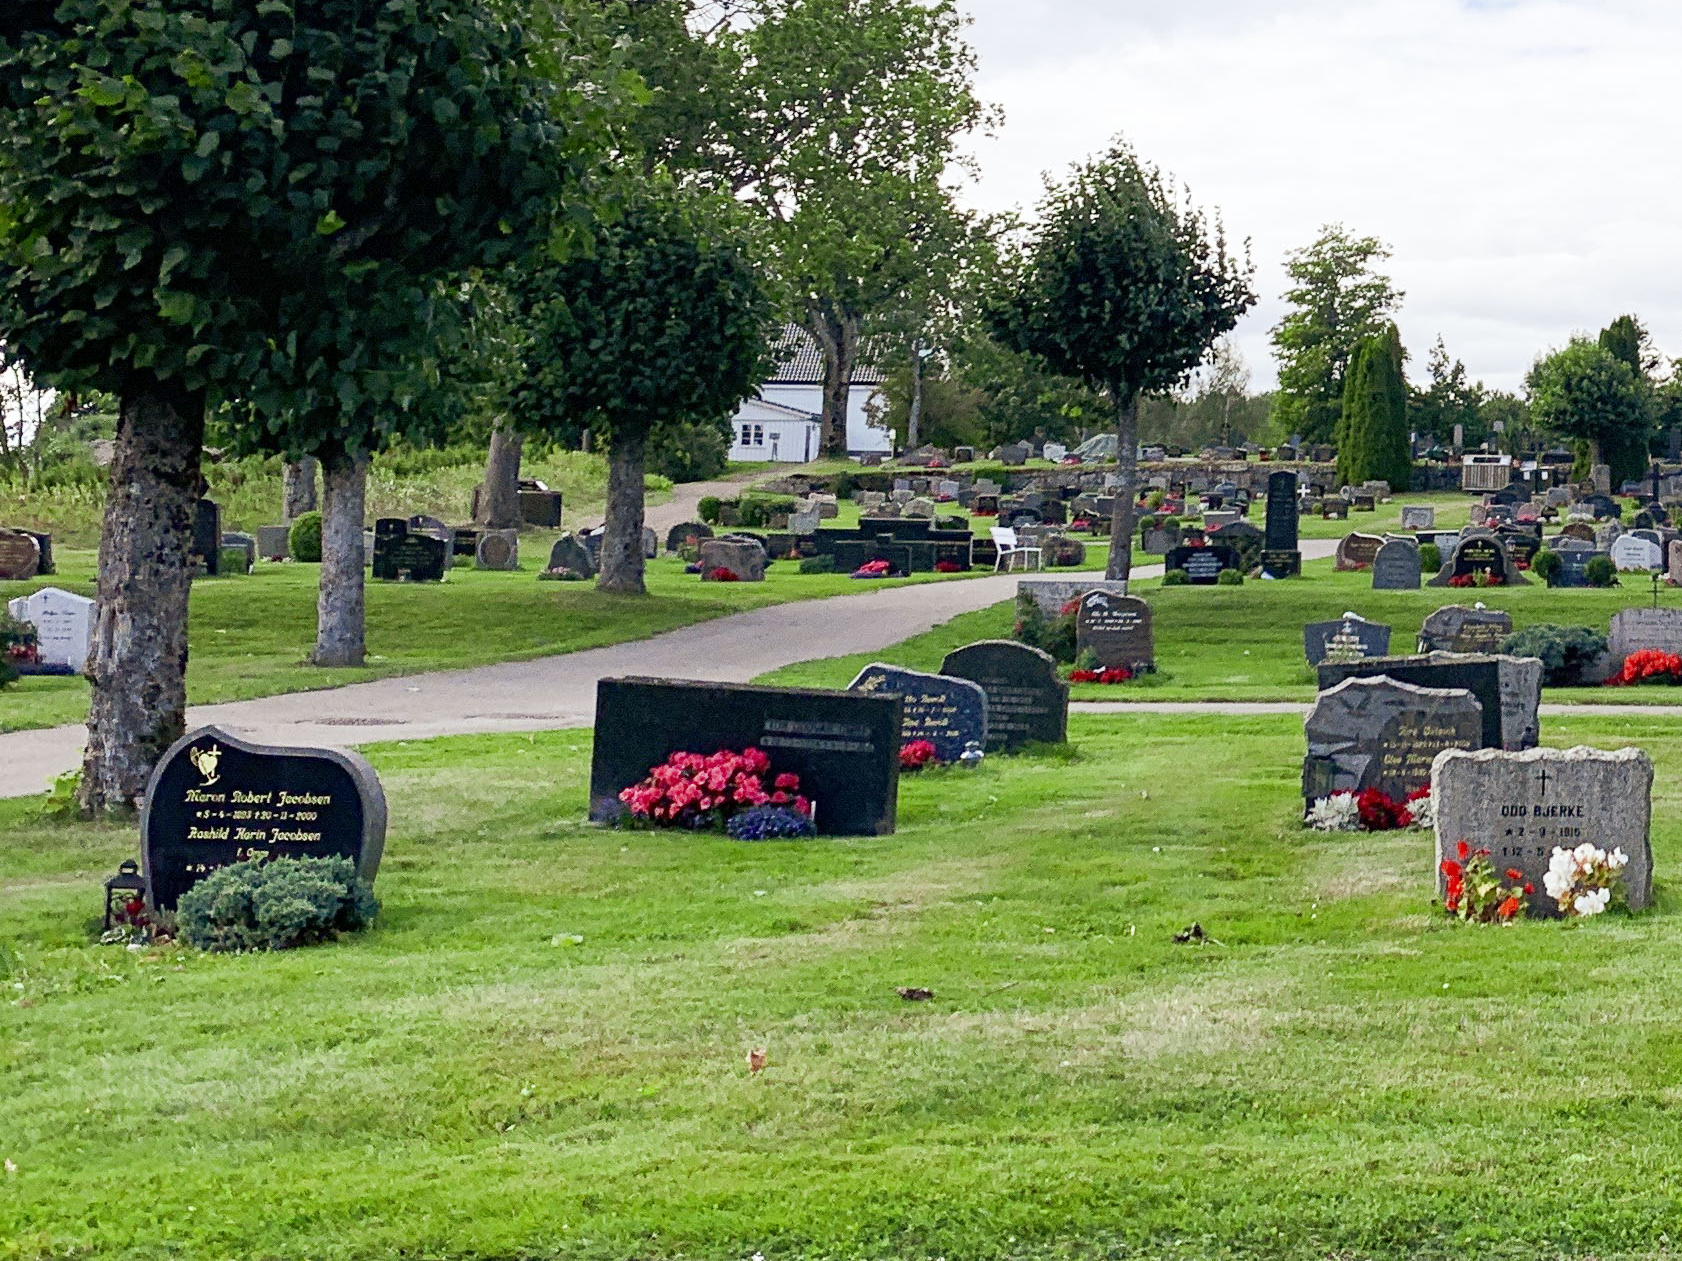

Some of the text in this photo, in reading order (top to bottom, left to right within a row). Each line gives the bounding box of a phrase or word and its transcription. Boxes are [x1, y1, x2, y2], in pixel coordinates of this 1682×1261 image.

[231, 790, 272, 804] Robert
[276, 791, 331, 807] Jacobsen
[1502, 805, 1584, 818] ODD BJERKE
[269, 828, 322, 843] Jacobsen
